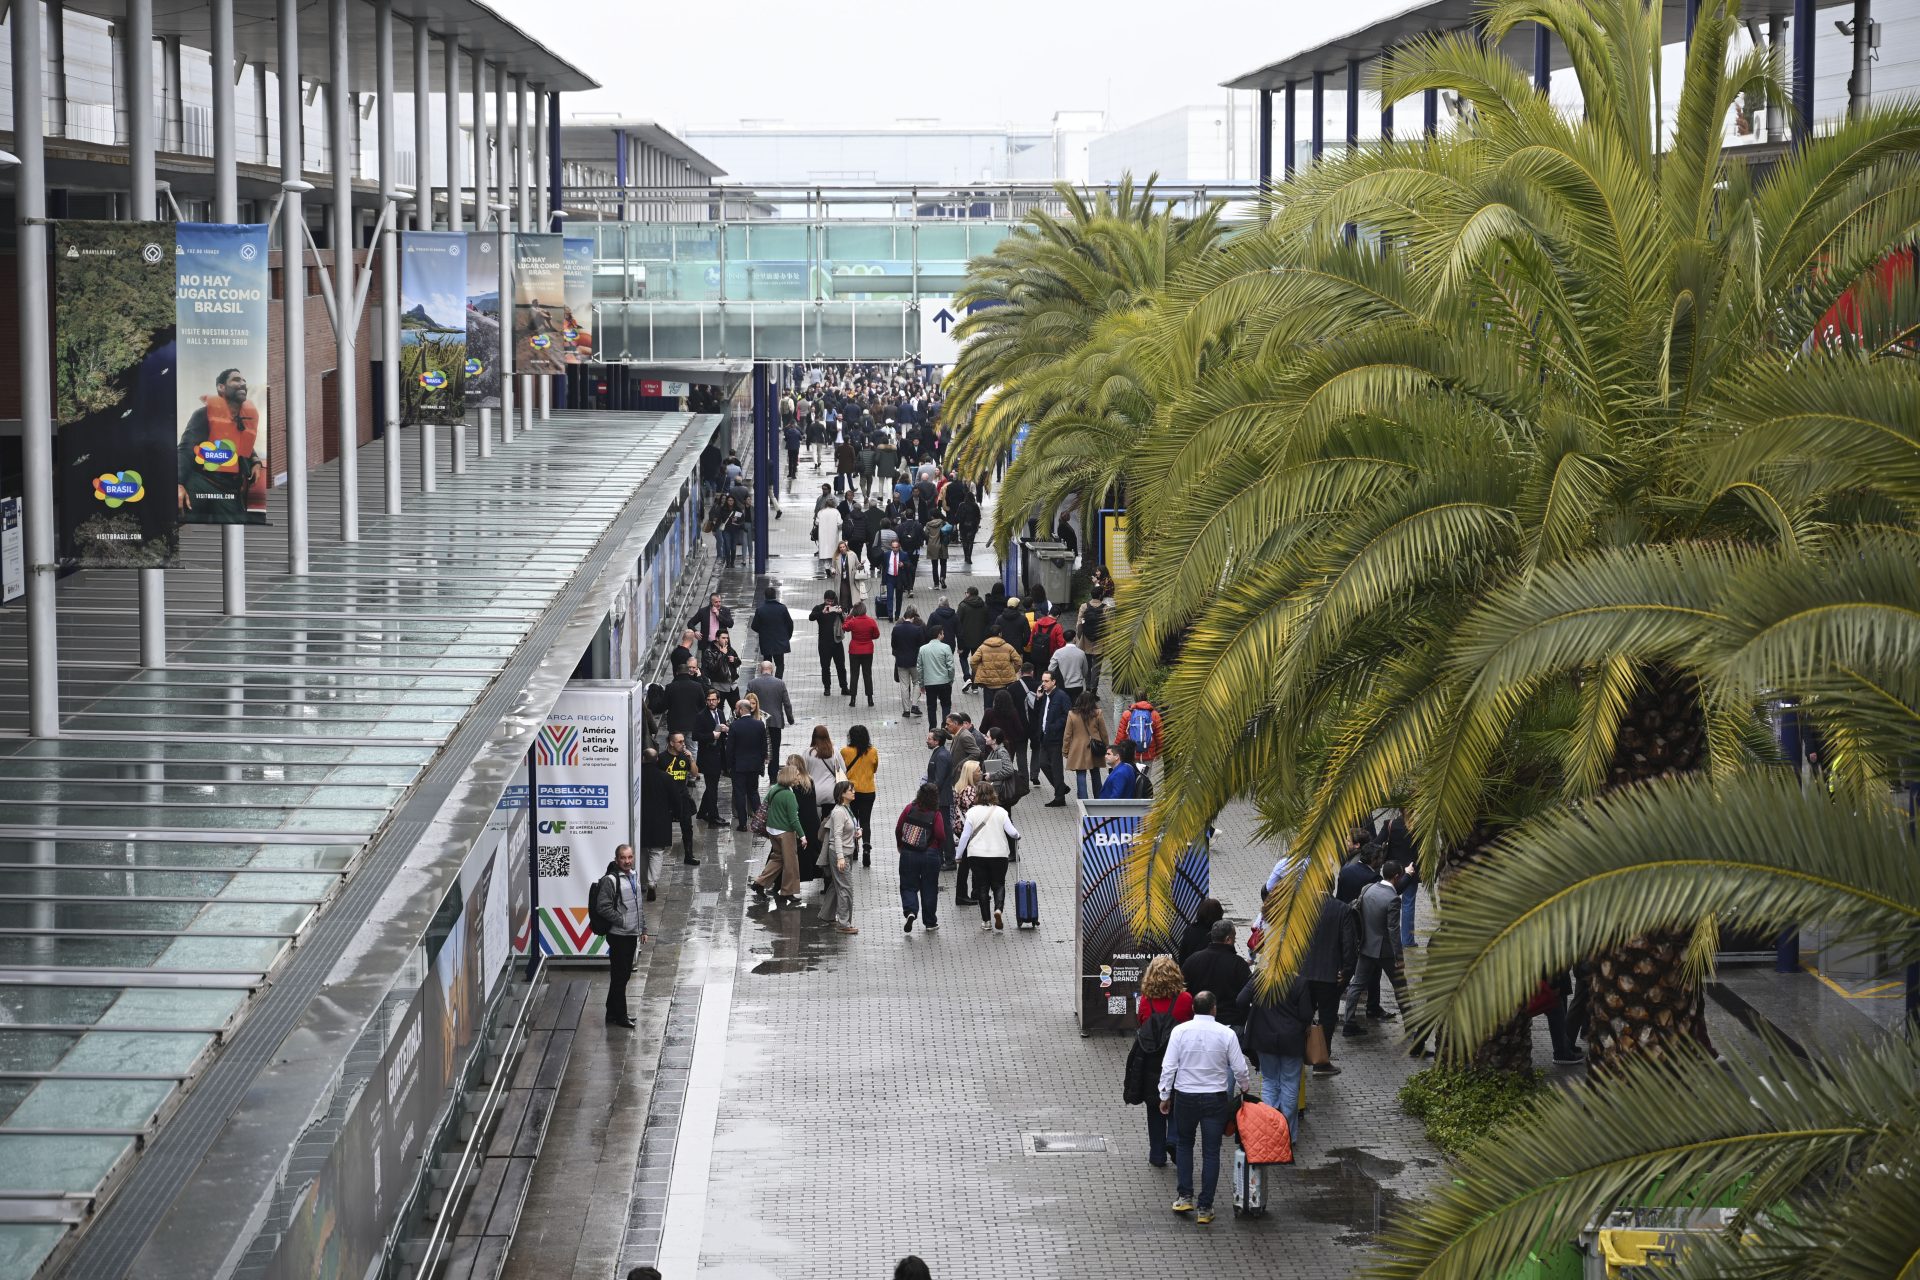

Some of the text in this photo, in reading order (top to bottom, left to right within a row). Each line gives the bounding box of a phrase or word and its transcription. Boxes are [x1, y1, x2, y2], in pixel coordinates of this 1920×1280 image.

[180, 275, 232, 286] NO HAY
[176, 288, 260, 300] UGAR COMO
[194, 302, 244, 314] BRASIL
[540, 786, 594, 794] PABELLÓN
[538, 820, 566, 834] CAF
[388, 1011, 422, 1105] GUATEMALA
